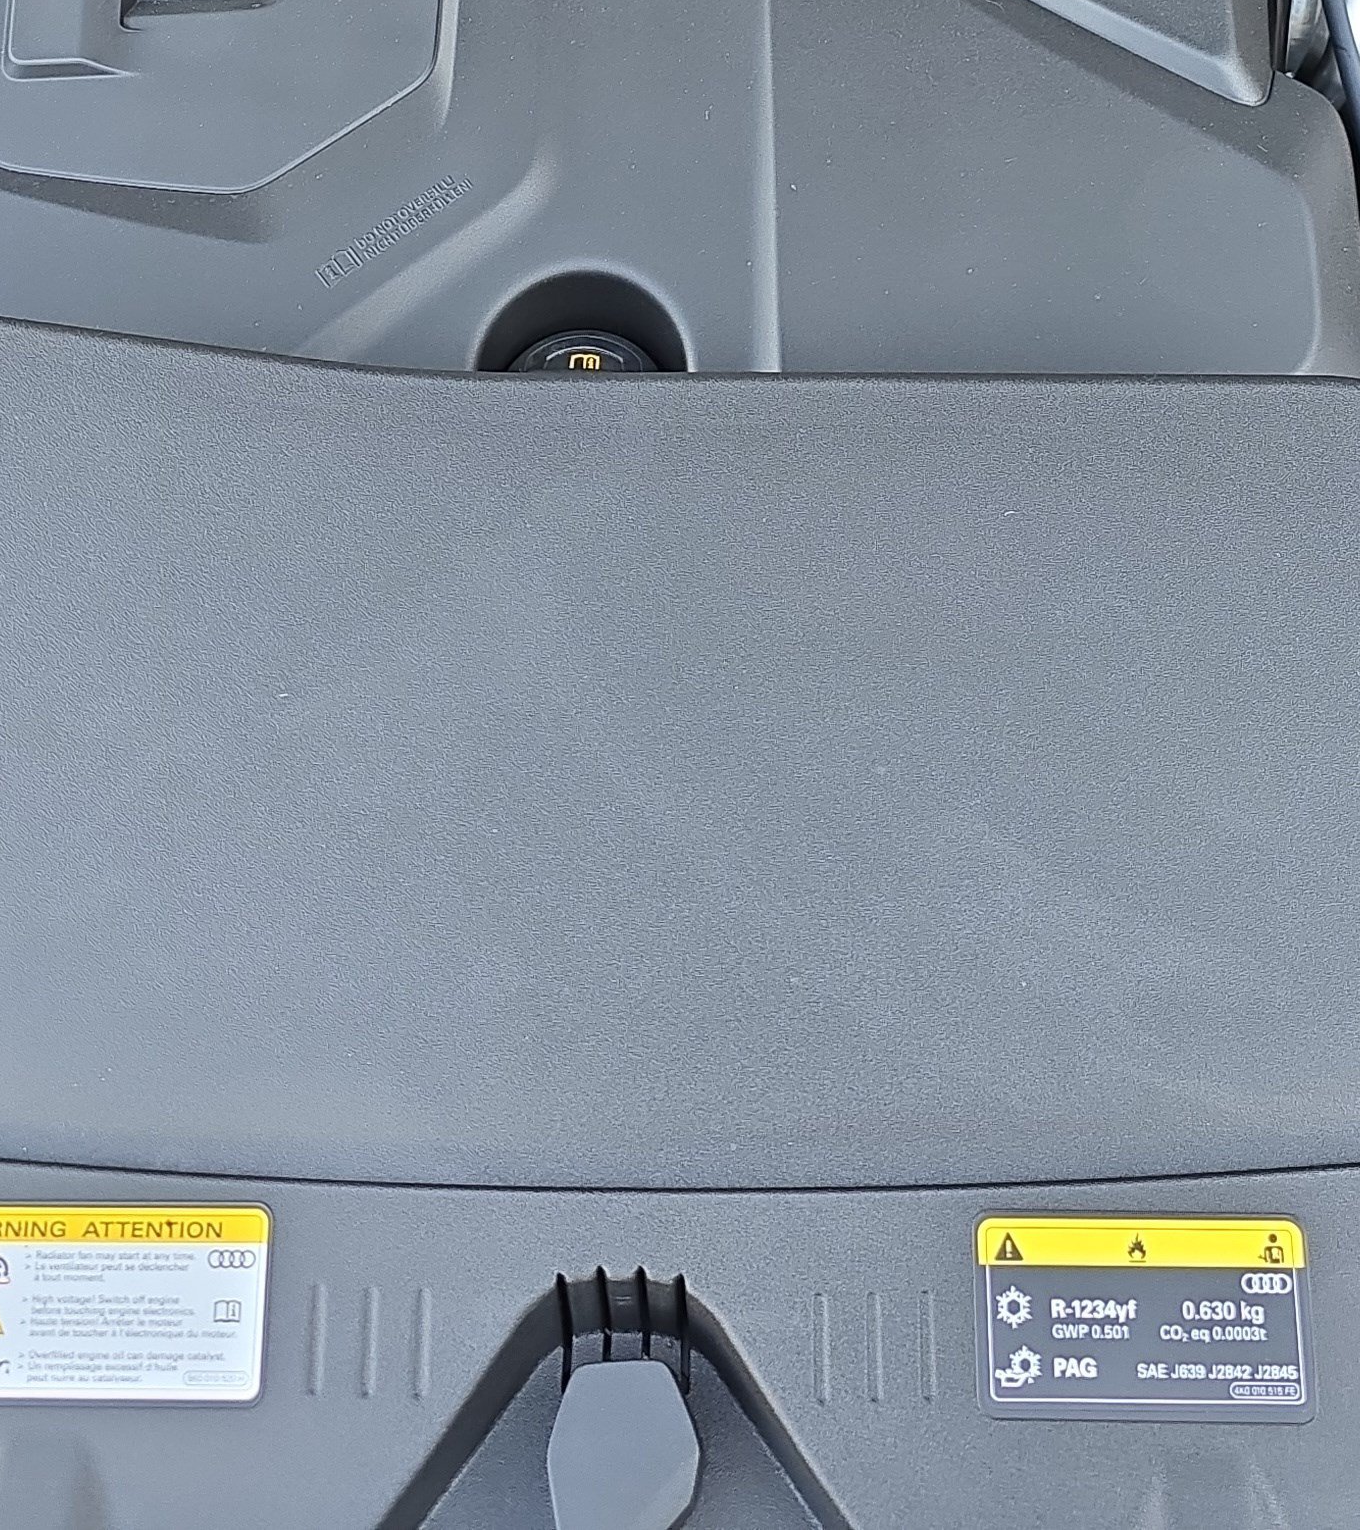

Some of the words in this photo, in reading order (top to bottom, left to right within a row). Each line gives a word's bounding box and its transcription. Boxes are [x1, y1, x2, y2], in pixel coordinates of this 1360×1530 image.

[81, 1220, 224, 1239] ATTENTION
[35, 1250, 75, 1261] Radiator
[78, 1250, 94, 1261] fan
[95, 1252, 116, 1263] may
[118, 1250, 140, 1261] start
[142, 1251, 153, 1261] at
[155, 1252, 170, 1263] any
[101, 1262, 122, 1273] peut
[98, 1295, 130, 1306] Switch
[147, 1297, 181, 1307] engine
[1050, 1299, 1138, 1323] R-1234yf
[1182, 1300, 1236, 1320] 0.630
[1239, 1301, 1265, 1325] kg
[1052, 1324, 1089, 1339] GWP
[1091, 1325, 1130, 1339] 0.501
[1190, 1327, 1211, 1343] eq
[1212, 1326, 1268, 1341] 0.0003t
[1053, 1357, 1098, 1378] PAG
[1136, 1363, 1169, 1379] SAE
[1170, 1363, 1207, 1380] J639
[1208, 1364, 1252, 1380] J2842
[1253, 1365, 1299, 1380] J2845
